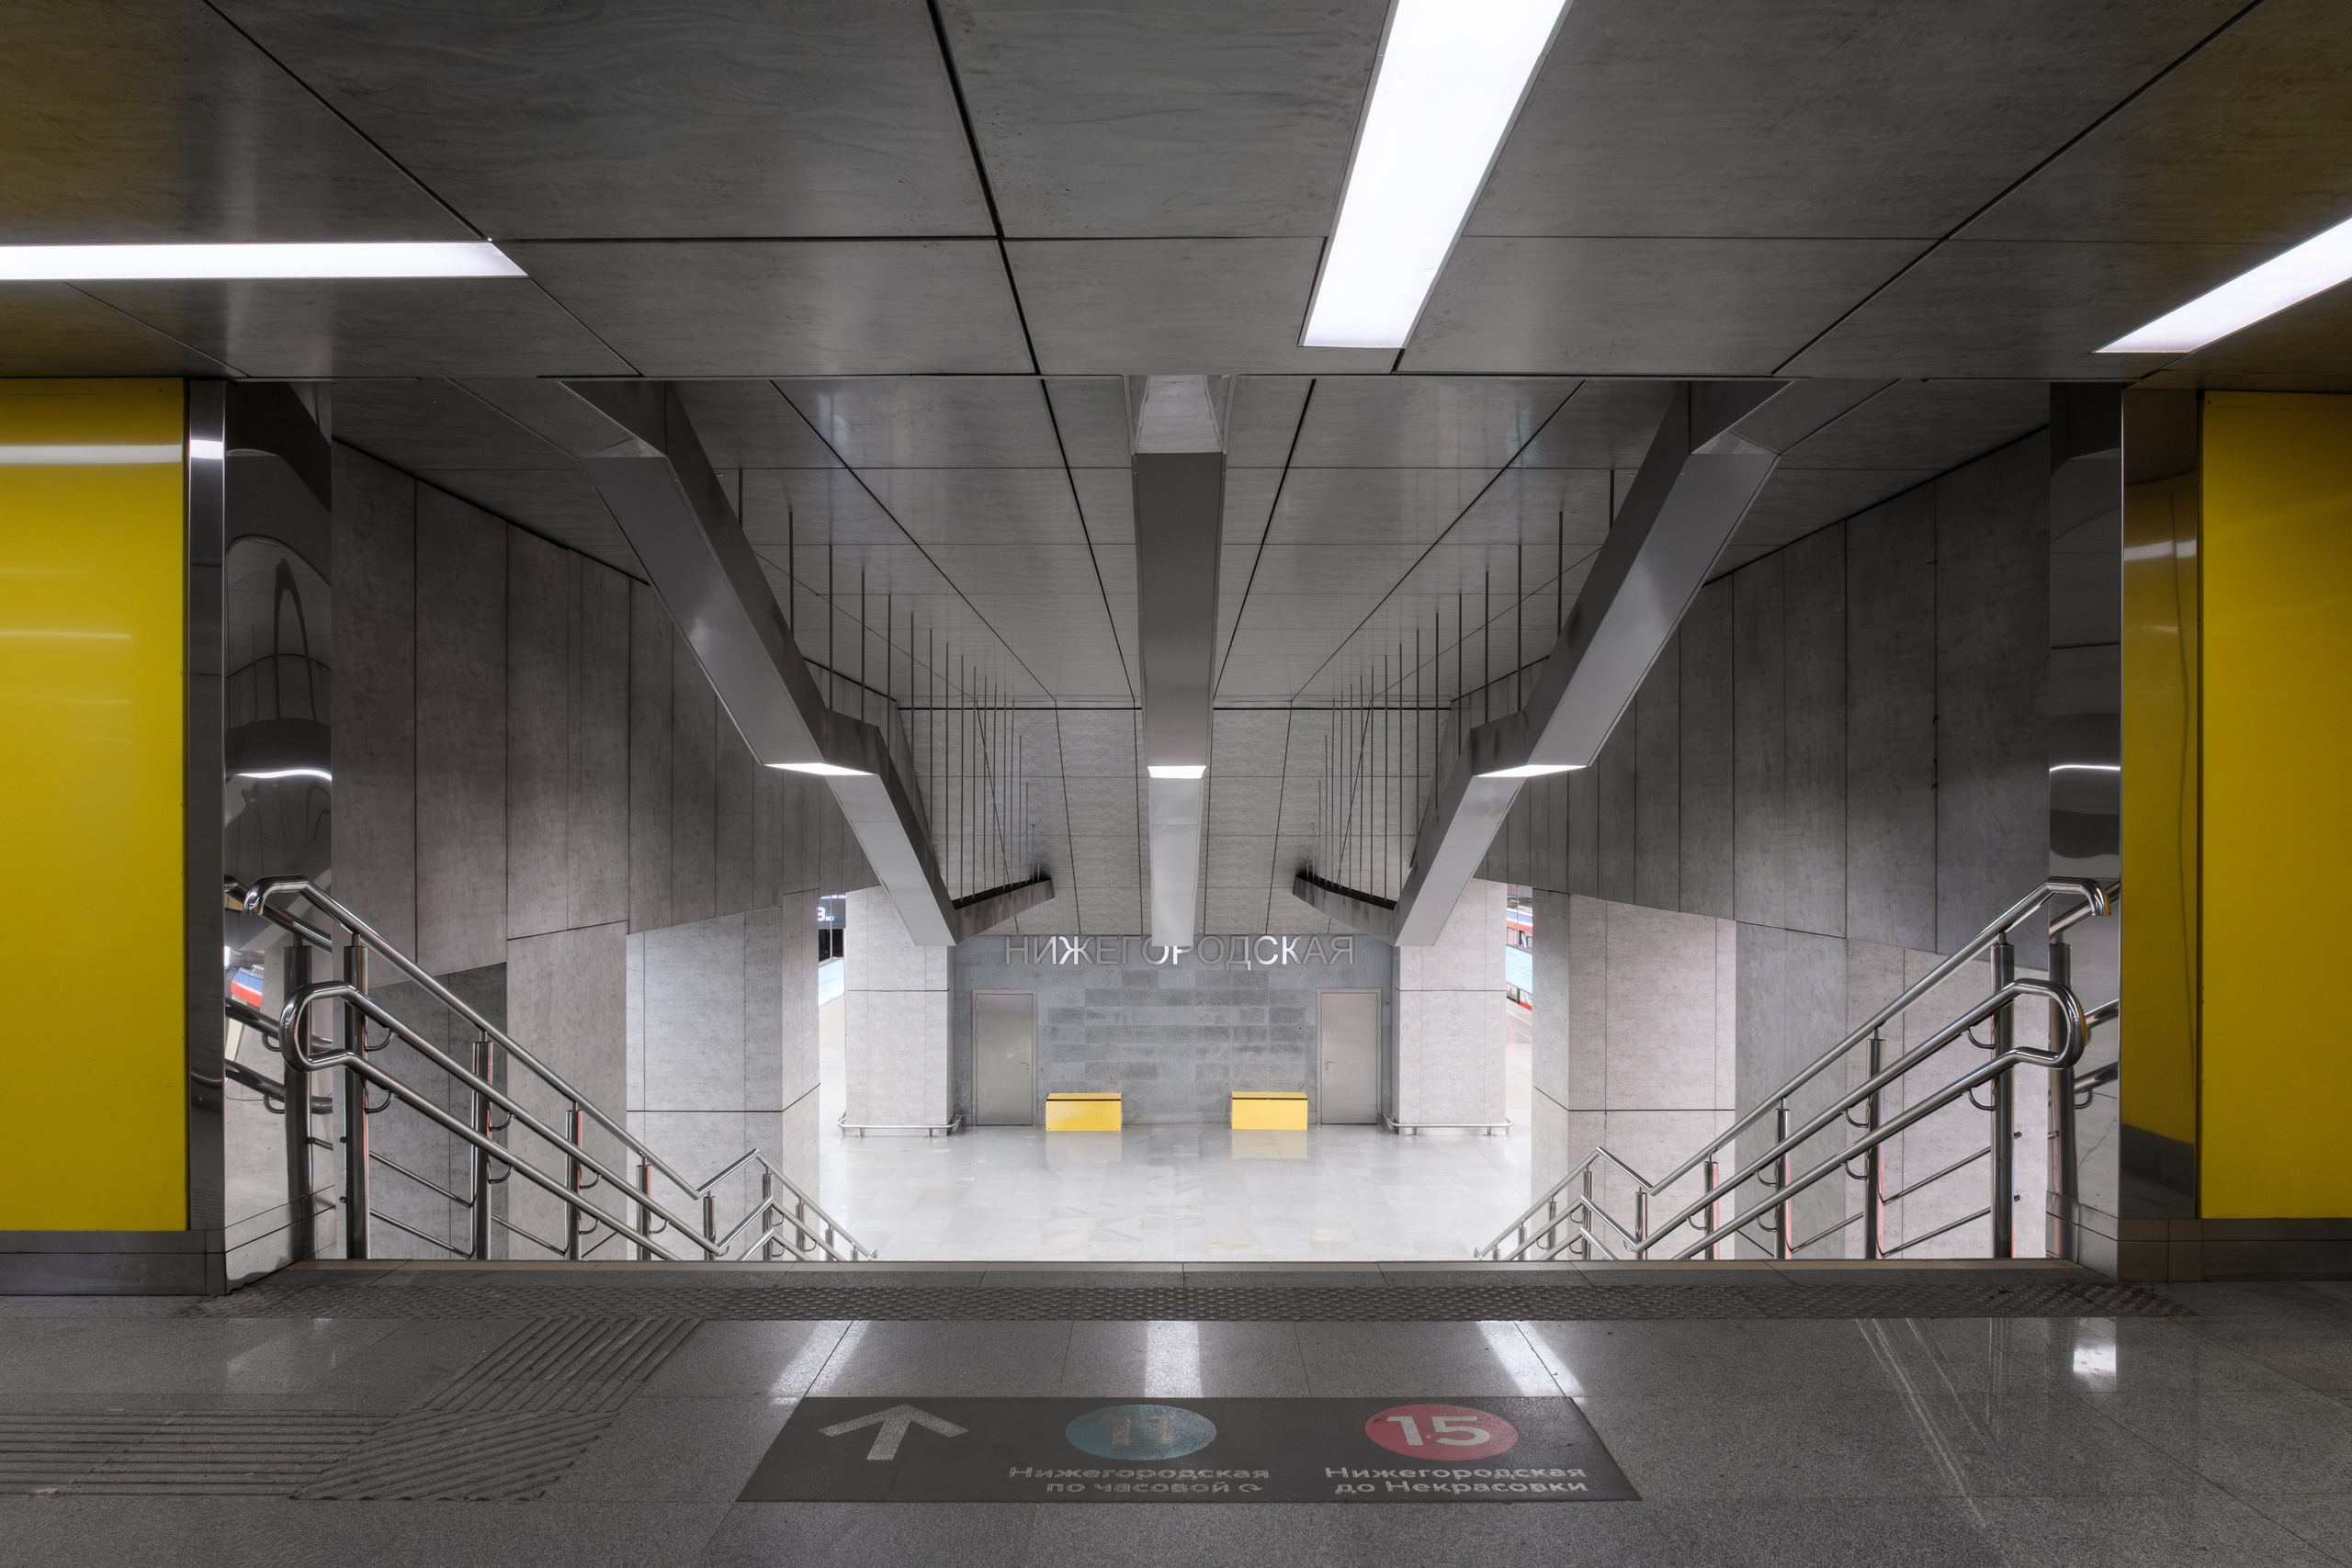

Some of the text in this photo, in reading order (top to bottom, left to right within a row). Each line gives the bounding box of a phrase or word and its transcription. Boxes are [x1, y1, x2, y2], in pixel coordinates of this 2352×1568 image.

[1005, 936, 1354, 970] НИЖЕГОРОДСКАЯ
[1100, 1416, 1173, 1447] 11
[1386, 1416, 1490, 1446] 15
[1009, 1467, 1270, 1480] Нижегородская
[1325, 1467, 1587, 1479] Нижегородская
[1046, 1481, 1229, 1493] по часовой
[1335, 1481, 1589, 1495] до Некрасовки
